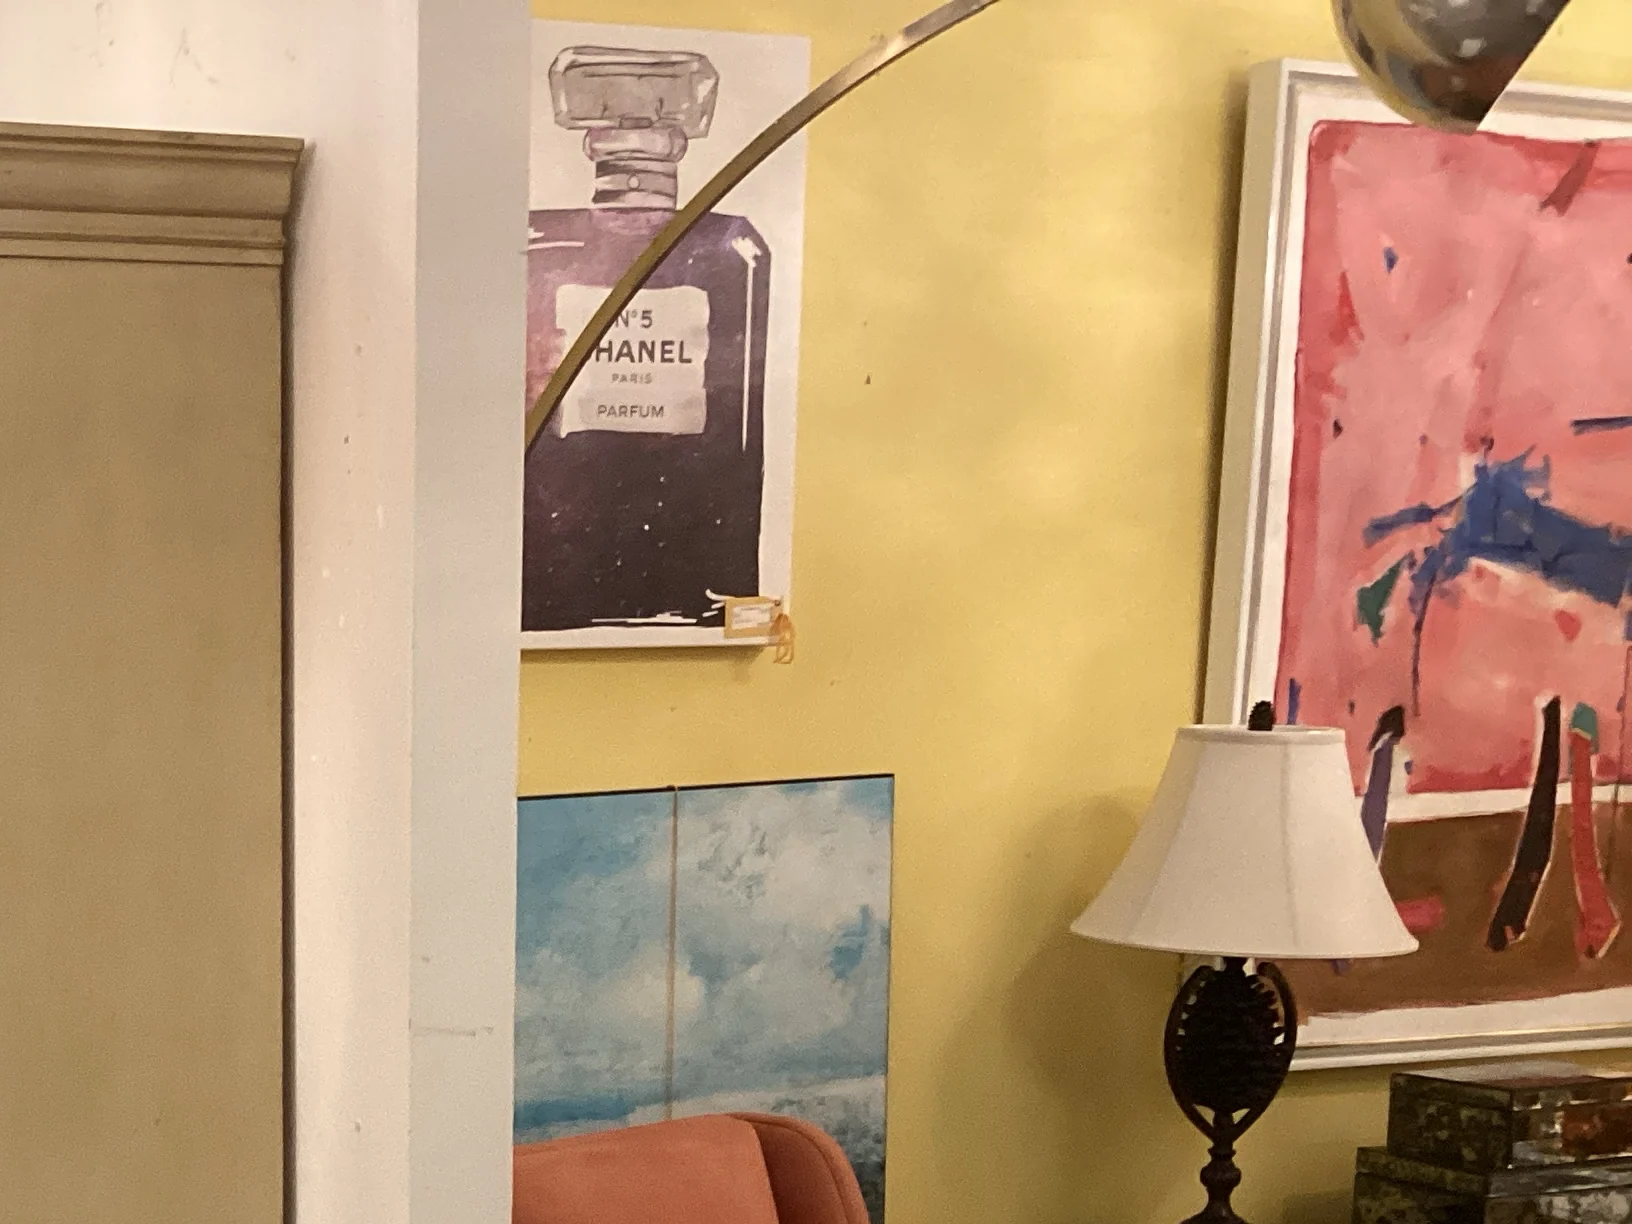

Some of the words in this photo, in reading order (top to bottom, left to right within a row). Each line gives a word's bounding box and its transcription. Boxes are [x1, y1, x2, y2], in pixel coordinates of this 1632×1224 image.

[594, 340, 693, 364] HANEL
[611, 372, 654, 385] PARIS
[597, 404, 665, 418] PARFUM
